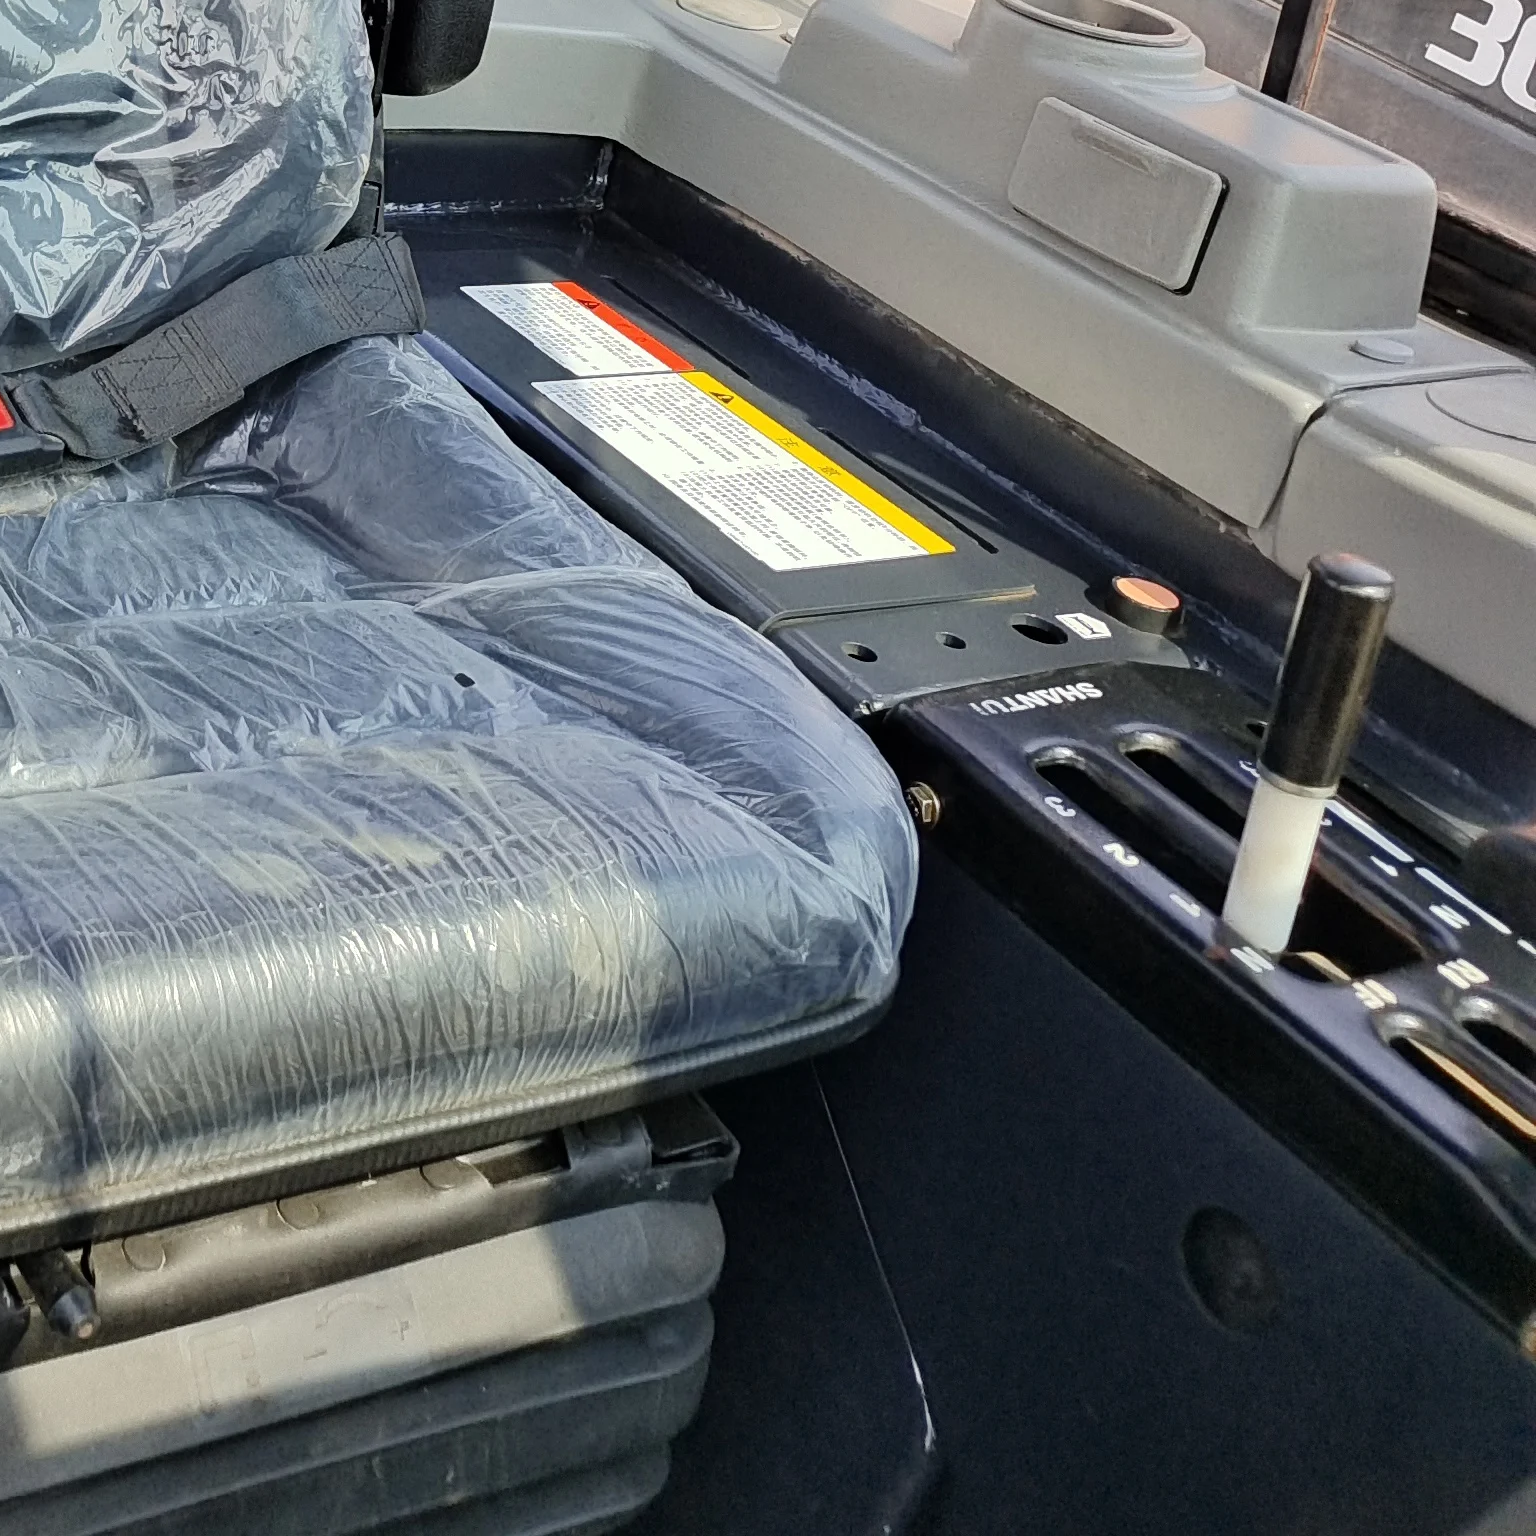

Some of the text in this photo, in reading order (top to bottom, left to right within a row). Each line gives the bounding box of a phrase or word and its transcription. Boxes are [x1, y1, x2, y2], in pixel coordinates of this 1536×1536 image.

[969, 682, 1104, 716] SHANTUI
[1044, 796, 1077, 817] 3
[1102, 842, 1141, 867] 2
[1168, 892, 1201, 918] 1
[1229, 946, 1275, 973] N
